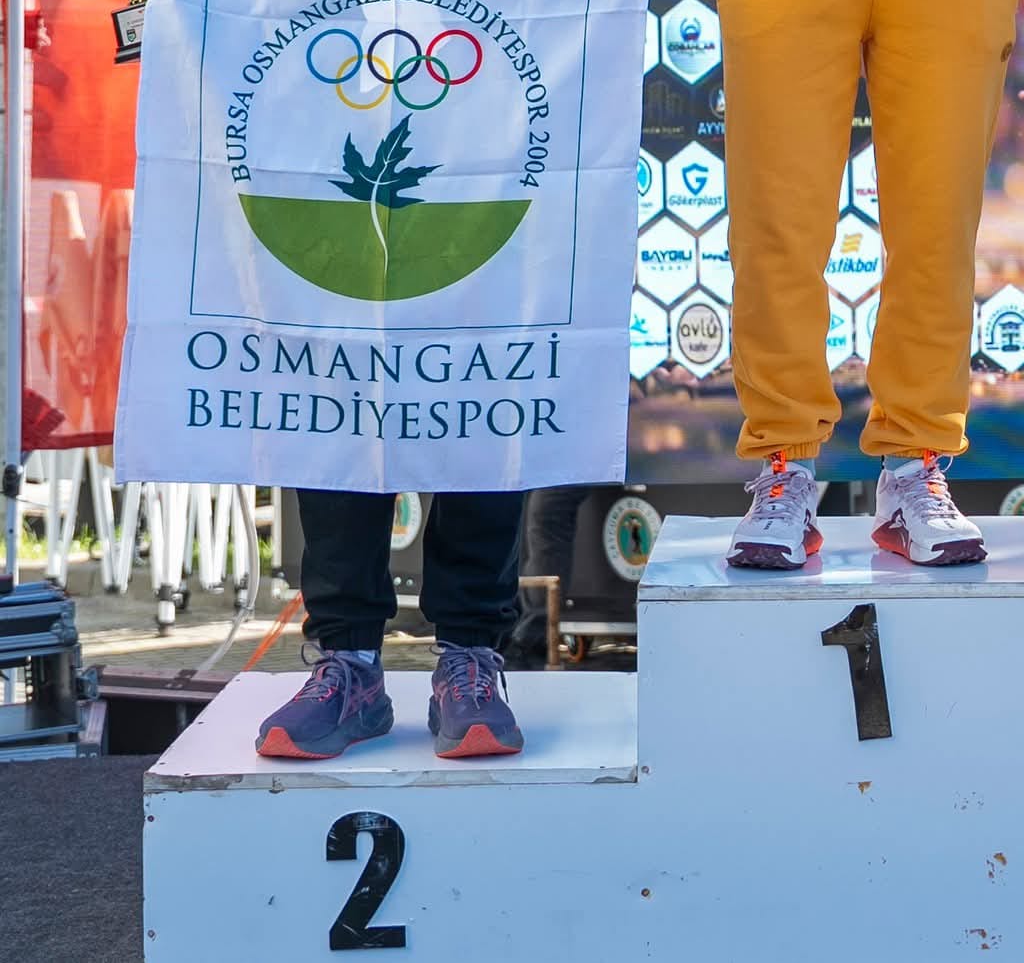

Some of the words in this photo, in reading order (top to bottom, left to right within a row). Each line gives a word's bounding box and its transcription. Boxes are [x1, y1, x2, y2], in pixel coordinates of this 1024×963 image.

[225, 91, 255, 183] BURSA
[520, 131, 550, 188] 2004
[187, 331, 562, 385] OSMANGAZİ
[186, 389, 566, 440] BELEDİYESPOR
[821, 603, 893, 741] 1
[326, 811, 406, 951] 2
